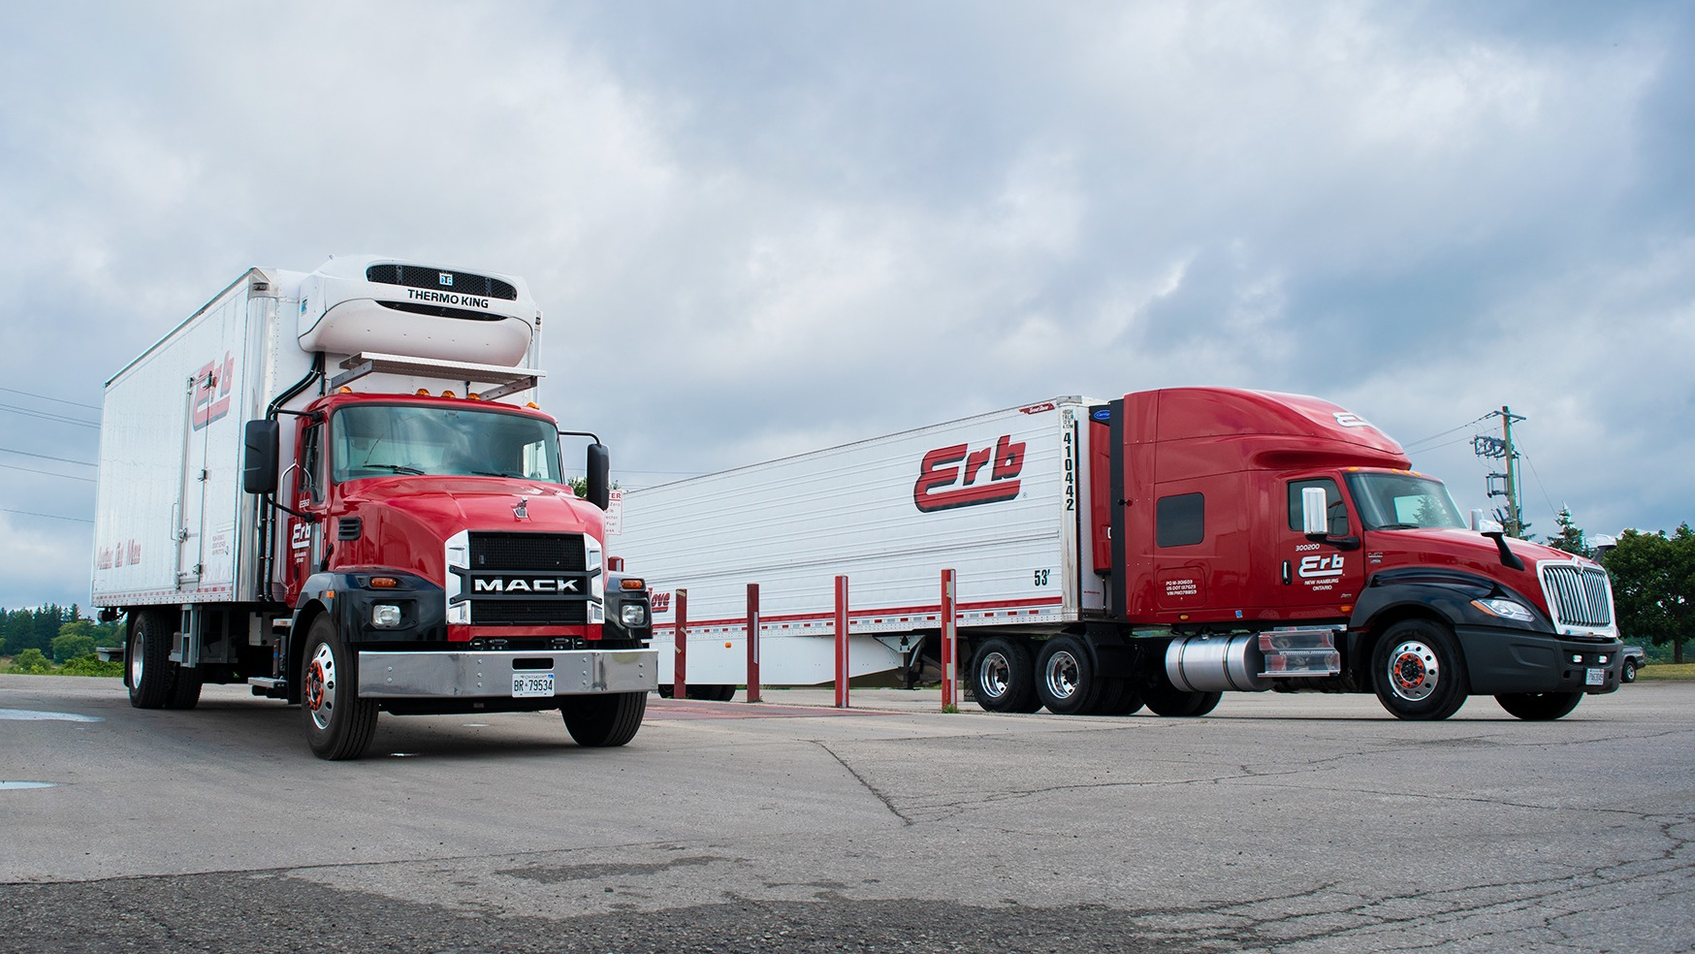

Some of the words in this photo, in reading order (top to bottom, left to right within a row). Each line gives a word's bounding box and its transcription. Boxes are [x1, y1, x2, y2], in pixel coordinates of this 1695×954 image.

[408, 288, 459, 304] THERMO
[461, 296, 489, 309] KING
[192, 350, 234, 432] Erb
[914, 434, 1026, 513] Erb
[1063, 432, 1074, 511] 410442
[292, 522, 311, 549] Erb
[1295, 543, 1320, 552] 300200
[1298, 554, 1345, 578] Erb
[474, 579, 579, 592] MACK
[1034, 569, 1051, 586] 53'
[514, 680, 524, 691] BR
[528, 680, 552, 691] 79534
